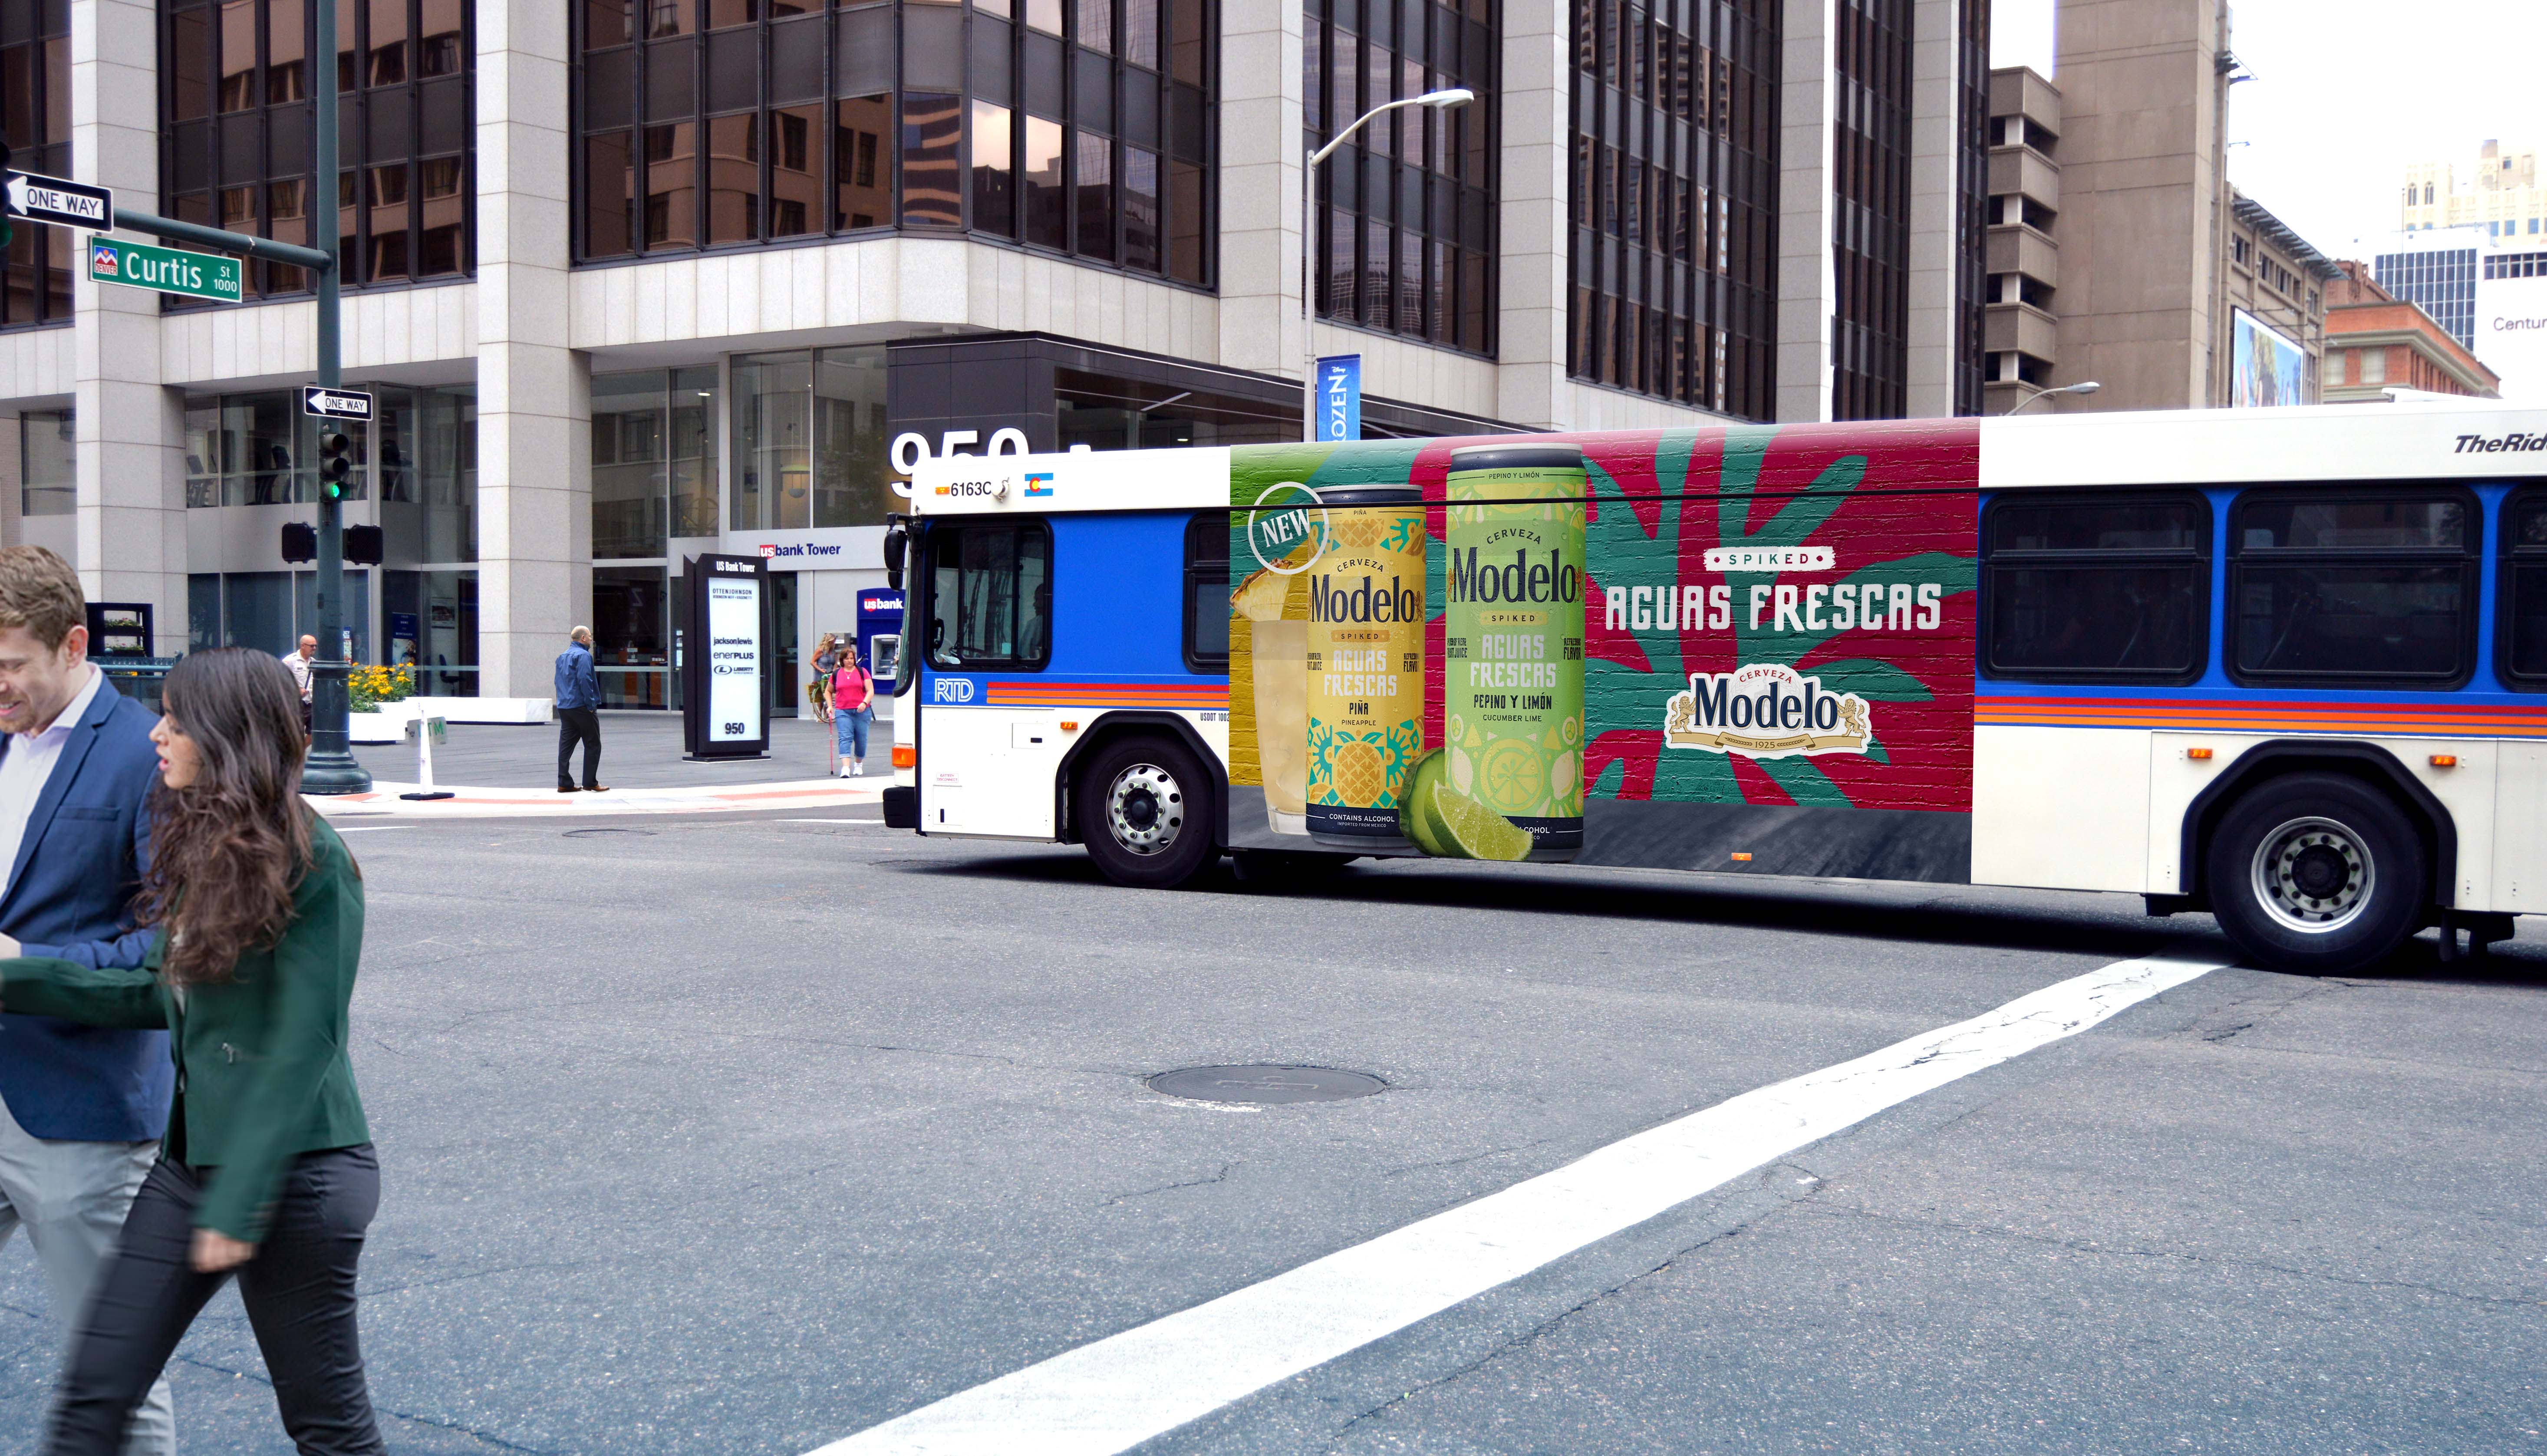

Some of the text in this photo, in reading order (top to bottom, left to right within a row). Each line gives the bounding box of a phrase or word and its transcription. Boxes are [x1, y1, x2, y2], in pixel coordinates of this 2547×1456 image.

[27, 188, 98, 216] ONE WAY
[95, 264, 118, 275] DENVER
[126, 252, 202, 289] Curtis
[220, 266, 230, 278] St
[213, 279, 237, 292] 1000
[326, 398, 364, 411] ONE WAY
[2454, 433, 2547, 453] TheRid
[951, 481, 992, 497] 6163C
[1261, 509, 1310, 548] NEW
[1486, 528, 1541, 545] CERVEZA
[807, 544, 841, 556] Tower
[716, 561, 755, 573] US Bank Tower
[1337, 558, 1384, 573] CERVEZA
[1729, 553, 1809, 565] SPIKED
[1453, 547, 1576, 603] Modelo
[1311, 574, 1415, 623] Modelo
[1605, 583, 1942, 632] AGUAS FRESCAS
[1482, 634, 1544, 659] AGUAS
[1333, 650, 1386, 672] AGUAS
[1470, 662, 1556, 688] FRESCAS
[1739, 669, 1793, 684] CERVEZA
[935, 678, 974, 702] RTD
[1324, 674, 1397, 697] FRESCAS
[1349, 700, 1368, 715] PIÑA
[1474, 692, 1552, 709] PEPINO Y LIMÓN
[1694, 678, 1839, 730] Modelo
[1200, 712, 1216, 721] USDOT
[725, 722, 745, 735] 950
